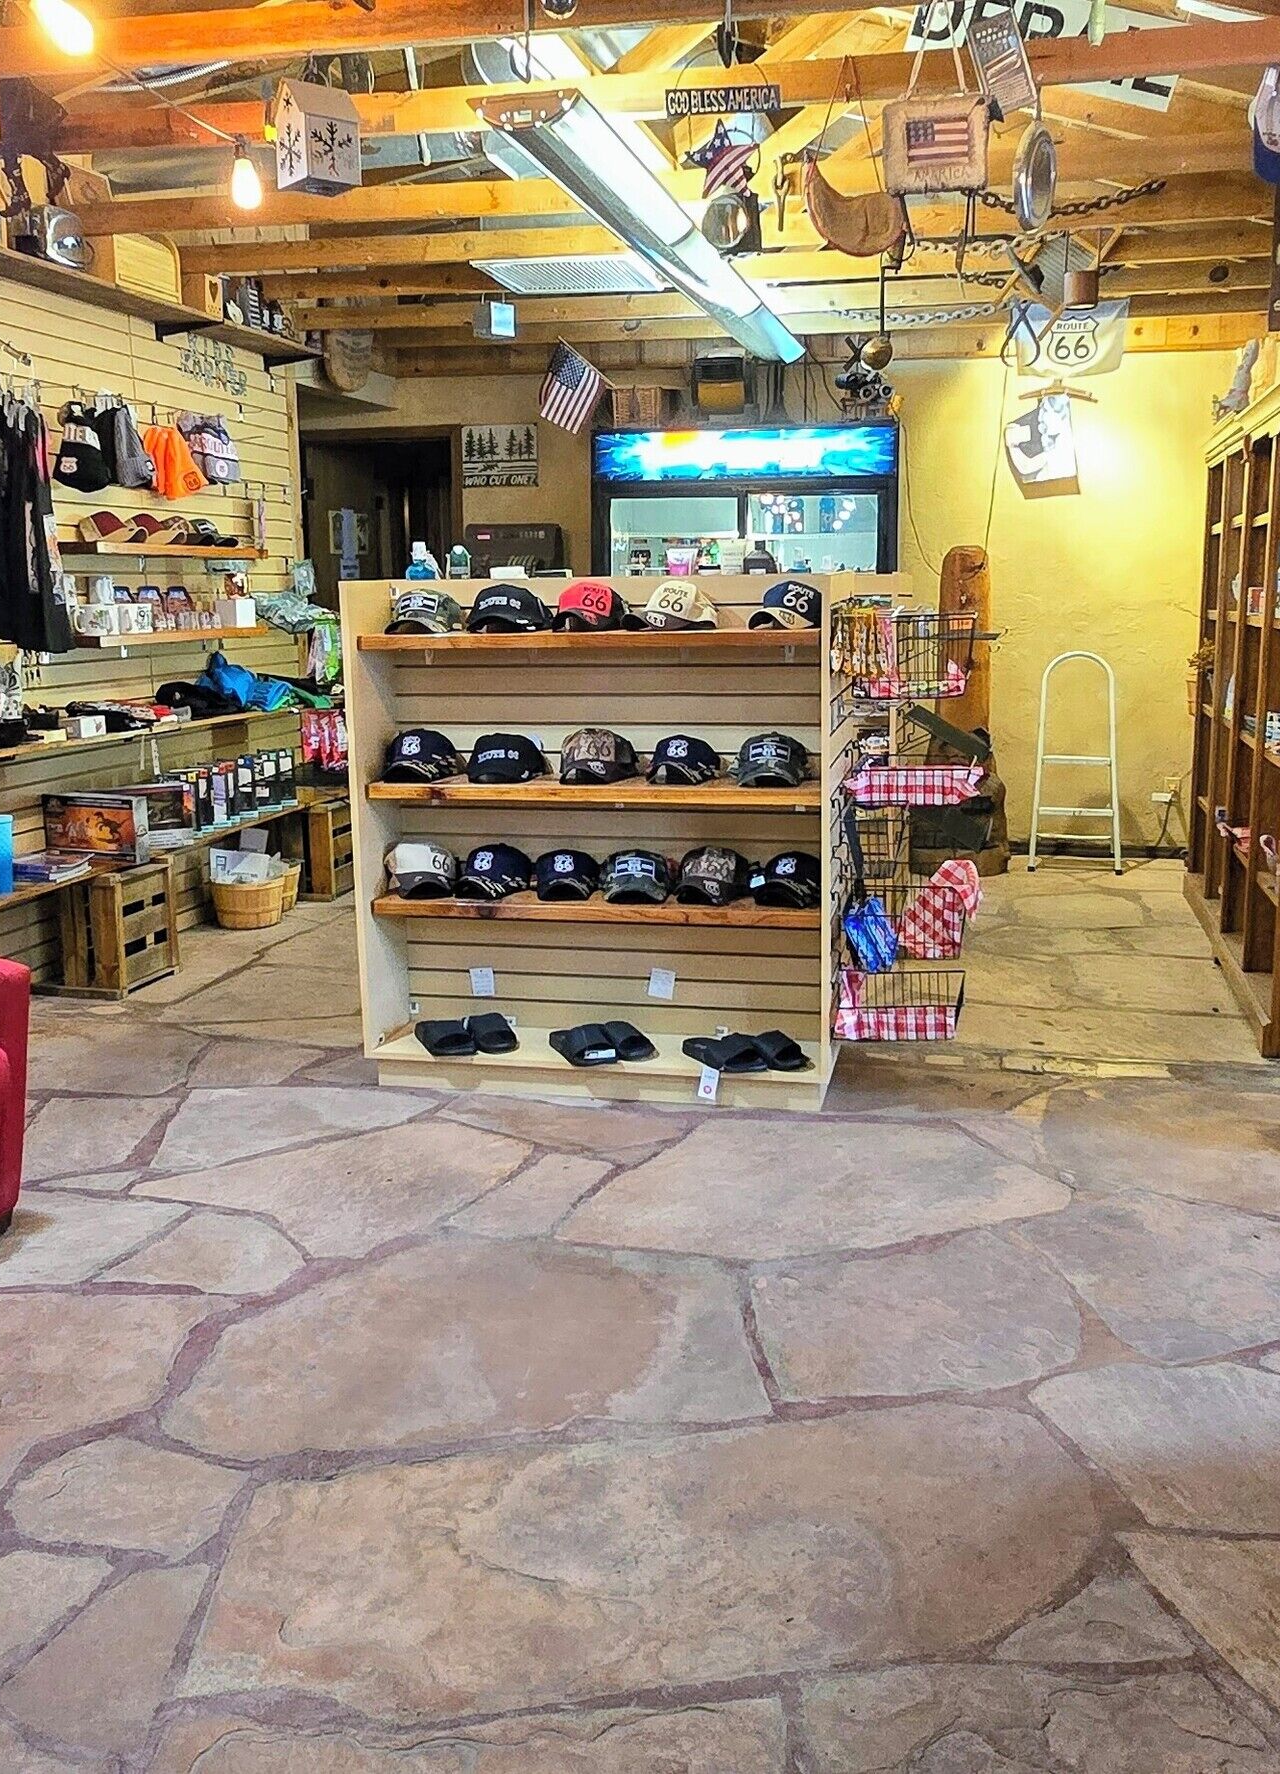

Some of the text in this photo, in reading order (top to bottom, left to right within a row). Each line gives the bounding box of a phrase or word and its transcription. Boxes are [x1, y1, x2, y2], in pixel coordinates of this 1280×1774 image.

[667, 88, 779, 114] GOD BLESS AMERICA
[1056, 322, 1088, 331] ROUTE
[1054, 335, 1090, 360] 66
[465, 474, 535, 486] WHO CUT ONE?
[583, 586, 608, 596] ROUTE
[662, 587, 689, 597] ROUTE
[788, 584, 814, 600] ROUTE
[581, 594, 607, 611] 66
[658, 594, 683, 612] 66
[782, 592, 809, 613] 66
[432, 854, 450, 874] 66
